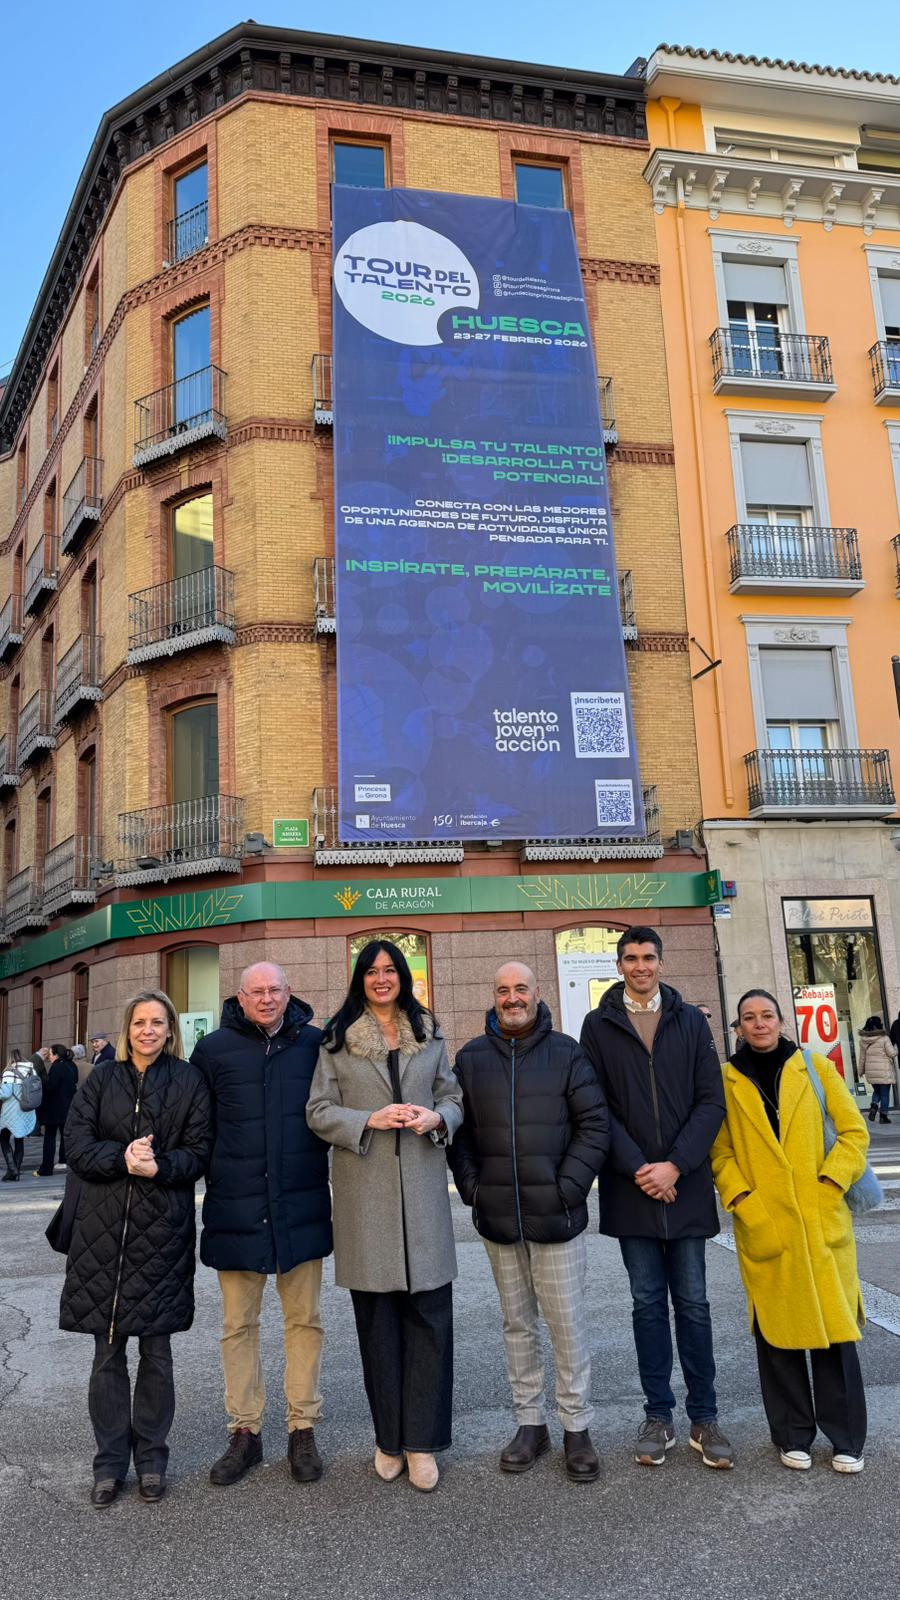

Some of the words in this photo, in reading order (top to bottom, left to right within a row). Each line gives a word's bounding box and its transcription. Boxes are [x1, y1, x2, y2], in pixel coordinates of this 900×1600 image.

[343, 254, 432, 280] TOUR
[435, 270, 471, 284] DEL
[344, 271, 472, 297] TALENTO
[381, 291, 436, 306] 2026
[452, 314, 585, 337] HUESCA
[453, 332, 491, 341] 23-27
[493, 334, 552, 345] FEBRERO
[554, 339, 588, 348] 2026
[388, 435, 477, 450] ¡IMPULSA
[480, 441, 508, 451] TU
[511, 442, 603, 457] TALENTO!
[442, 453, 574, 470] ¡DESARROLLA
[577, 460, 604, 471] TU
[493, 471, 605, 485] POTENCIAL!
[340, 505, 459, 520] OPORTUNIDADES
[461, 512, 480, 520] DE
[481, 513, 540, 524] FUTURO,
[542, 516, 607, 525] DISFRUTA
[415, 499, 481, 511] CONECTA
[483, 502, 513, 512] CON
[515, 504, 541, 513] LAS
[543, 506, 606, 515] MEJORES
[344, 516, 365, 525] DE
[366, 518, 396, 526] UNA
[398, 519, 455, 529] AGENDA
[457, 522, 476, 531] DE
[478, 524, 566, 534] ACTIVIDADES
[568, 525, 608, 535] ÚNICA
[489, 534, 553, 544] PENSADA
[555, 536, 590, 545] PARA
[591, 537, 609, 546] TI.
[345, 558, 470, 578] INSPÍRATE,
[474, 565, 610, 582] PREPÁRATE,
[483, 581, 611, 596] MOVILÍZATE
[574, 696, 621, 706] ¡Inscríbete!
[493, 708, 558, 724] talento
[495, 723, 545, 740] joven
[545, 724, 560, 733] en
[495, 737, 560, 752] acción
[371, 815, 416, 823] Ayuntamiento
[433, 814, 453, 827] 150
[366, 888, 398, 899] CAJA
[401, 887, 442, 898] RURAL
[375, 901, 389, 910] DE
[391, 899, 435, 910] ARAGÓN
[802, 990, 833, 1000] Rebajas
[796, 1004, 838, 1044] 70
